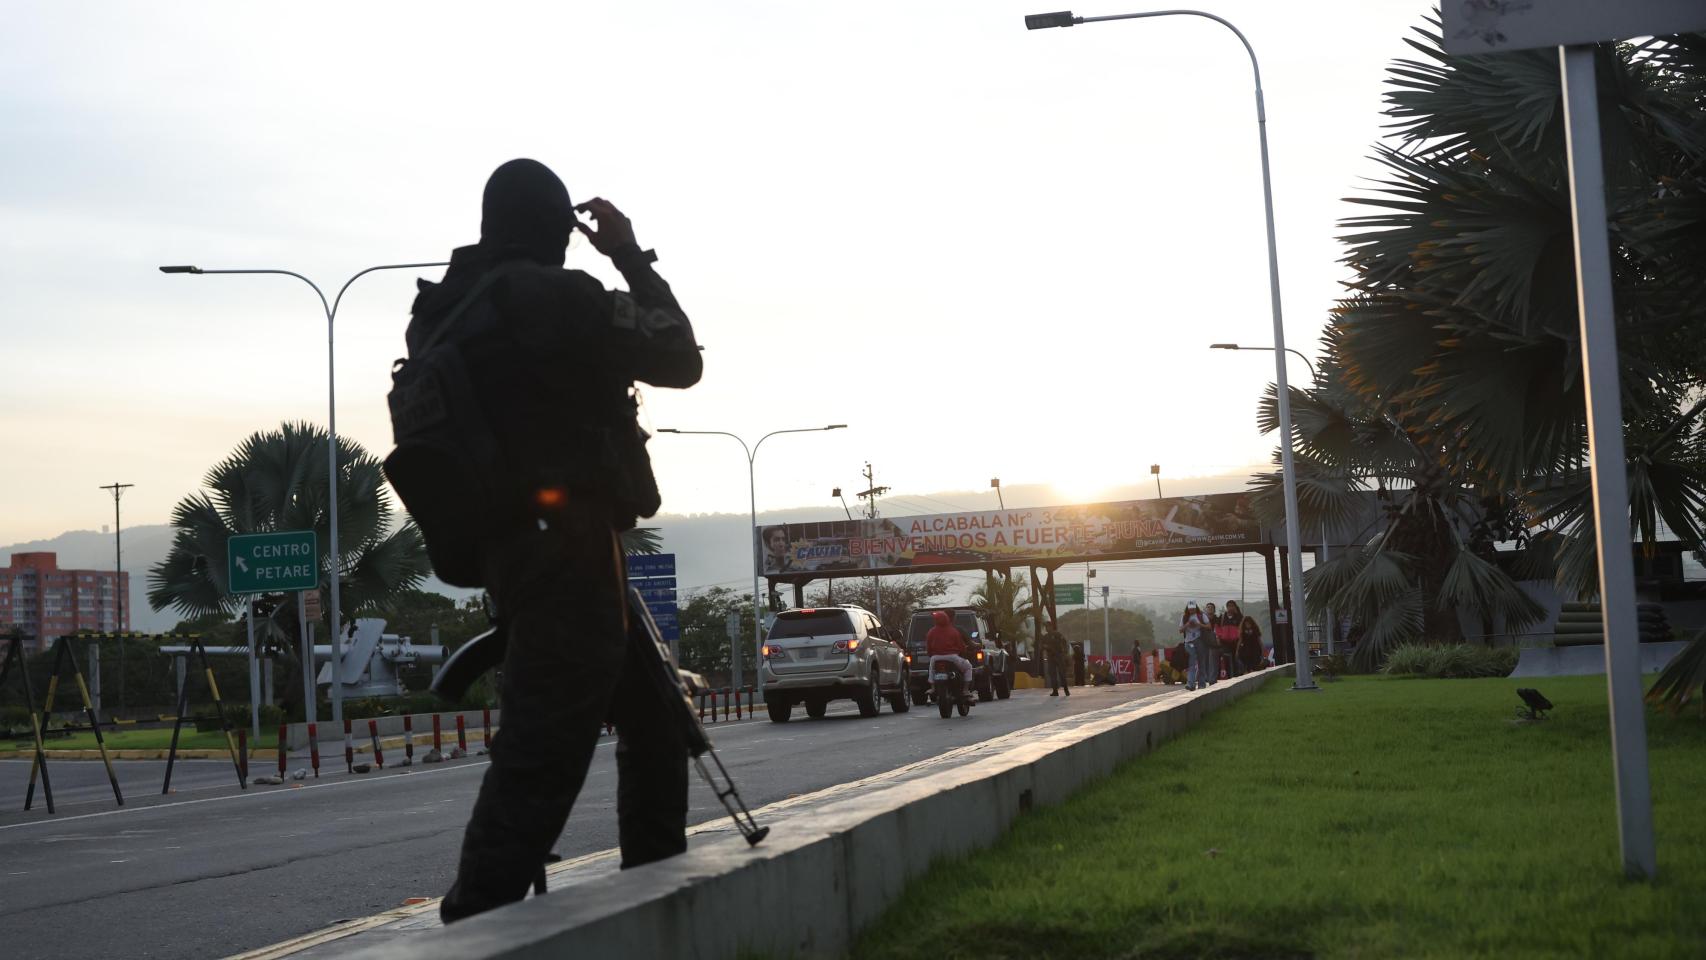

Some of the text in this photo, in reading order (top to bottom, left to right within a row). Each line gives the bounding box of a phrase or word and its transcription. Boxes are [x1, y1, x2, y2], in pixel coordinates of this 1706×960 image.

[911, 513, 1003, 533] ALCABALA
[849, 518, 1169, 556] BIENVENIDOS A FUERTE TIUNA
[253, 543, 310, 558] CENTRO
[256, 565, 311, 579] PETARE
